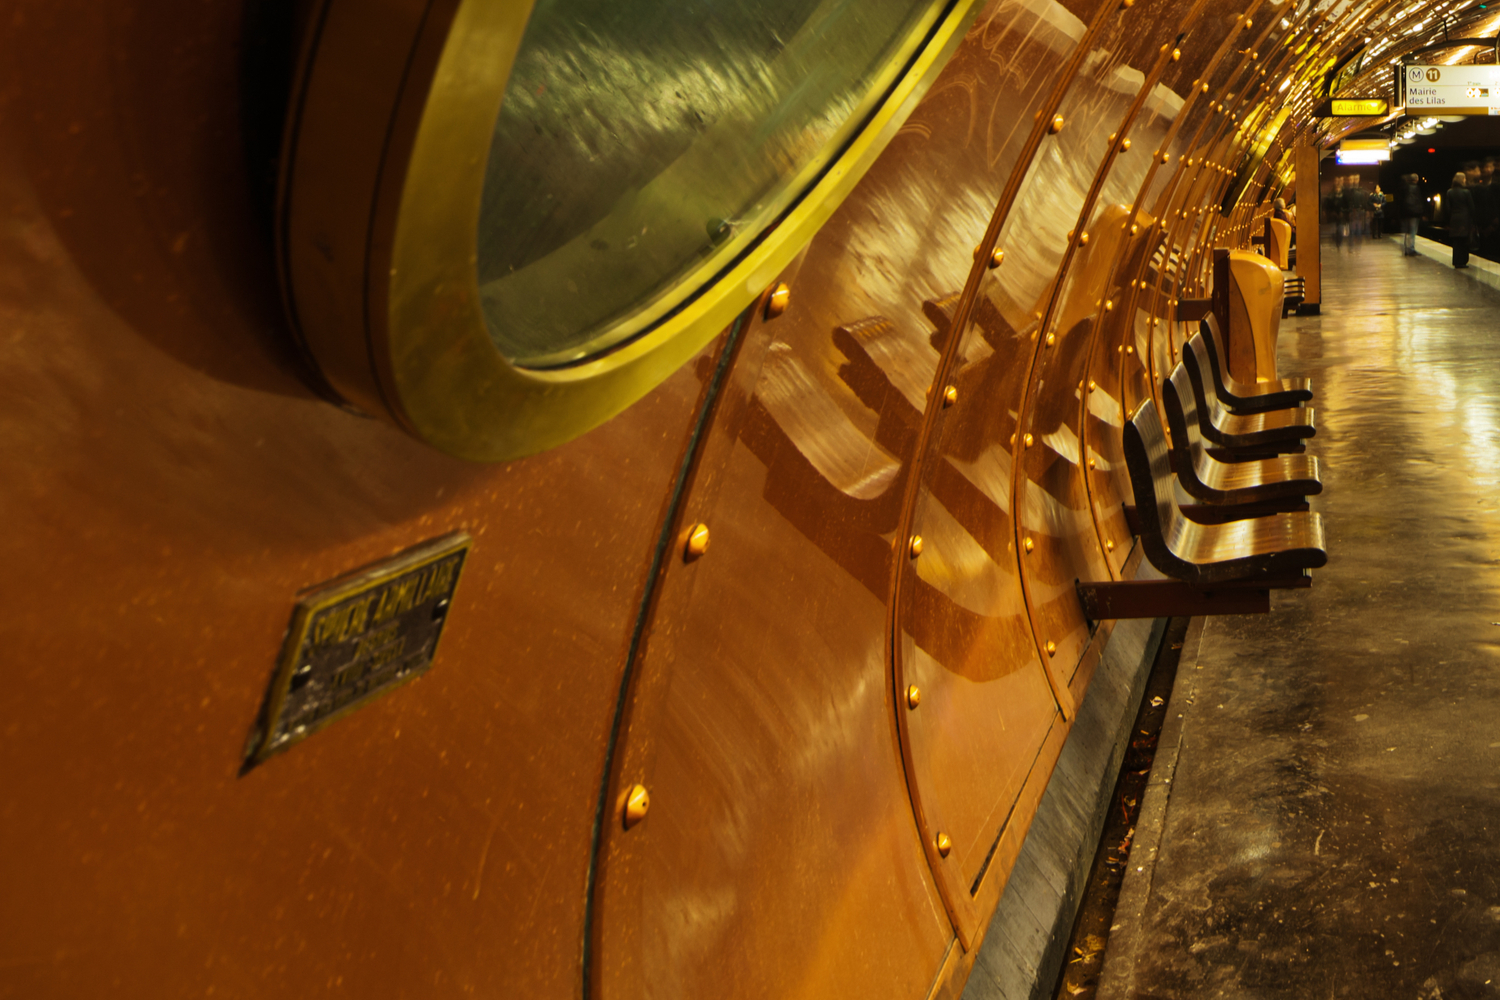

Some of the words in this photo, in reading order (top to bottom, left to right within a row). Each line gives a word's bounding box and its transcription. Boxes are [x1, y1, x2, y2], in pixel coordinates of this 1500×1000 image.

[1428, 71, 1438, 80] 11
[1409, 88, 1437, 96] Mairie
[1409, 97, 1424, 105] des
[1427, 97, 1446, 105] Lilas
[1337, 103, 1372, 111] Alarme
